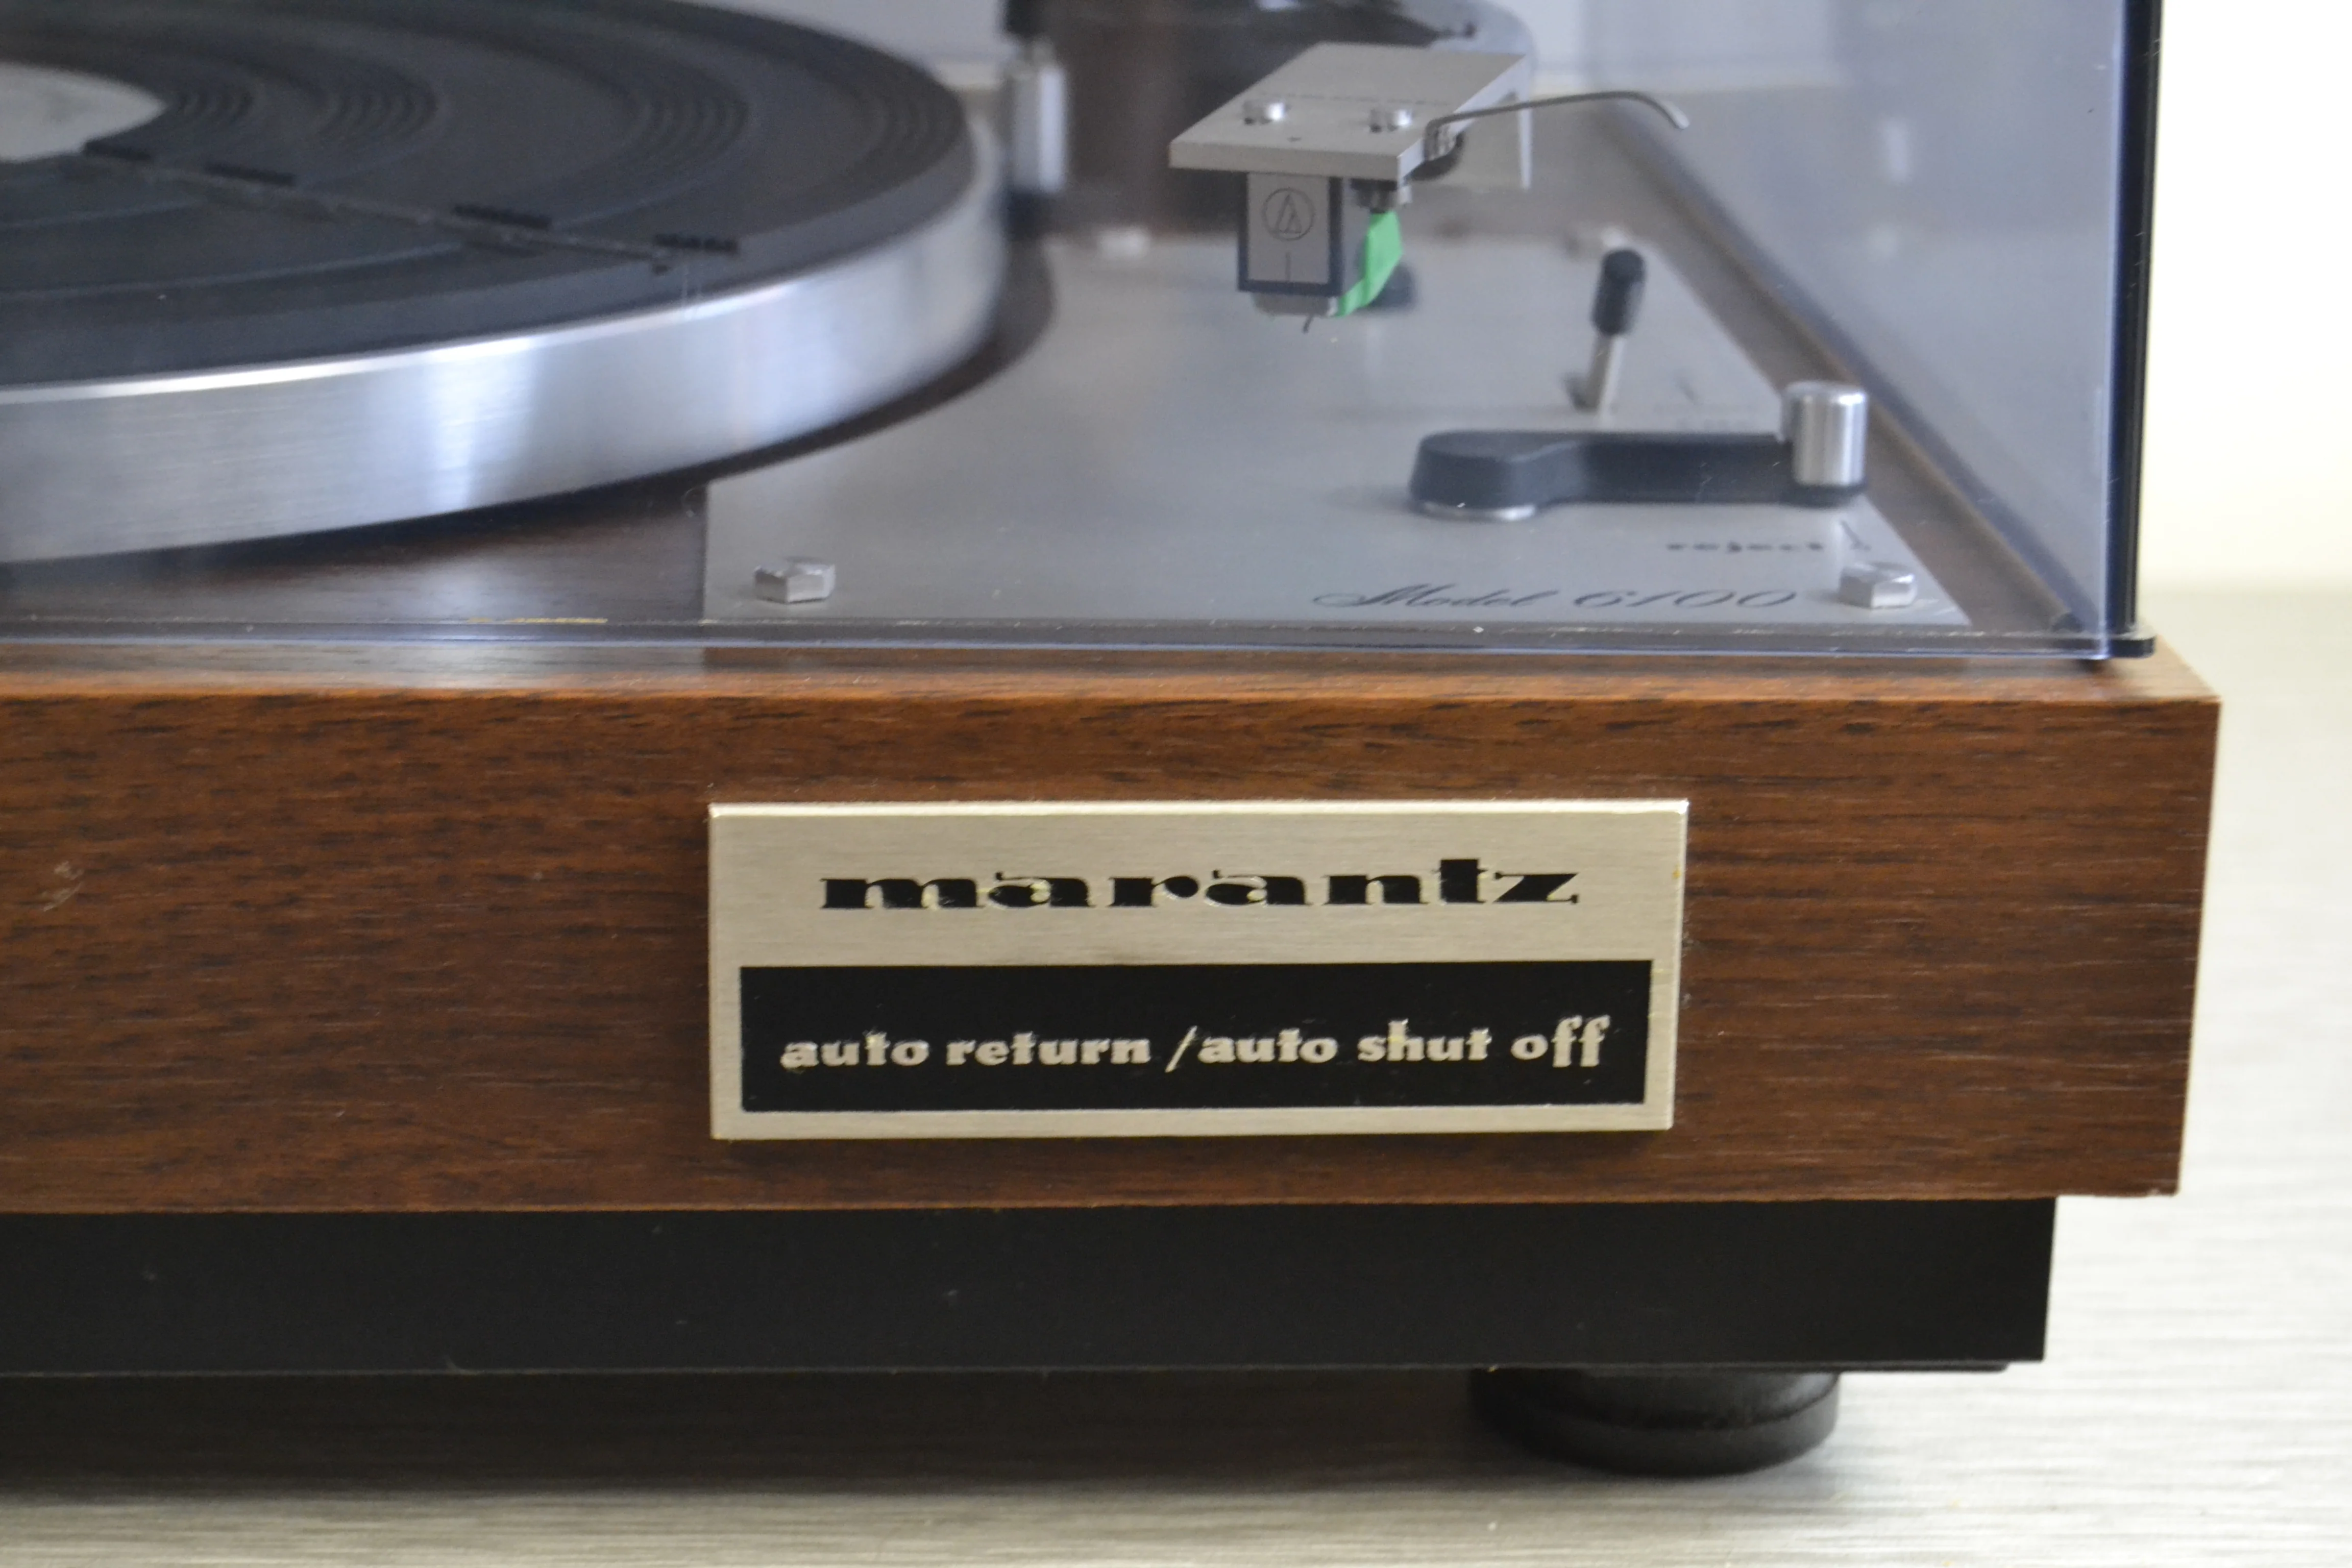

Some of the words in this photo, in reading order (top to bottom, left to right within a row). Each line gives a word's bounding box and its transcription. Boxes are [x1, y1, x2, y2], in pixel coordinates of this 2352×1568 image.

[1312, 583, 1559, 608] Model
[1573, 590, 1798, 608] 6100
[821, 857, 1579, 910] marantz
[779, 1030, 930, 1072] auto
[945, 1030, 1153, 1067] return
[1356, 1018, 1493, 1063] shut
[1509, 1014, 1611, 1068] off
